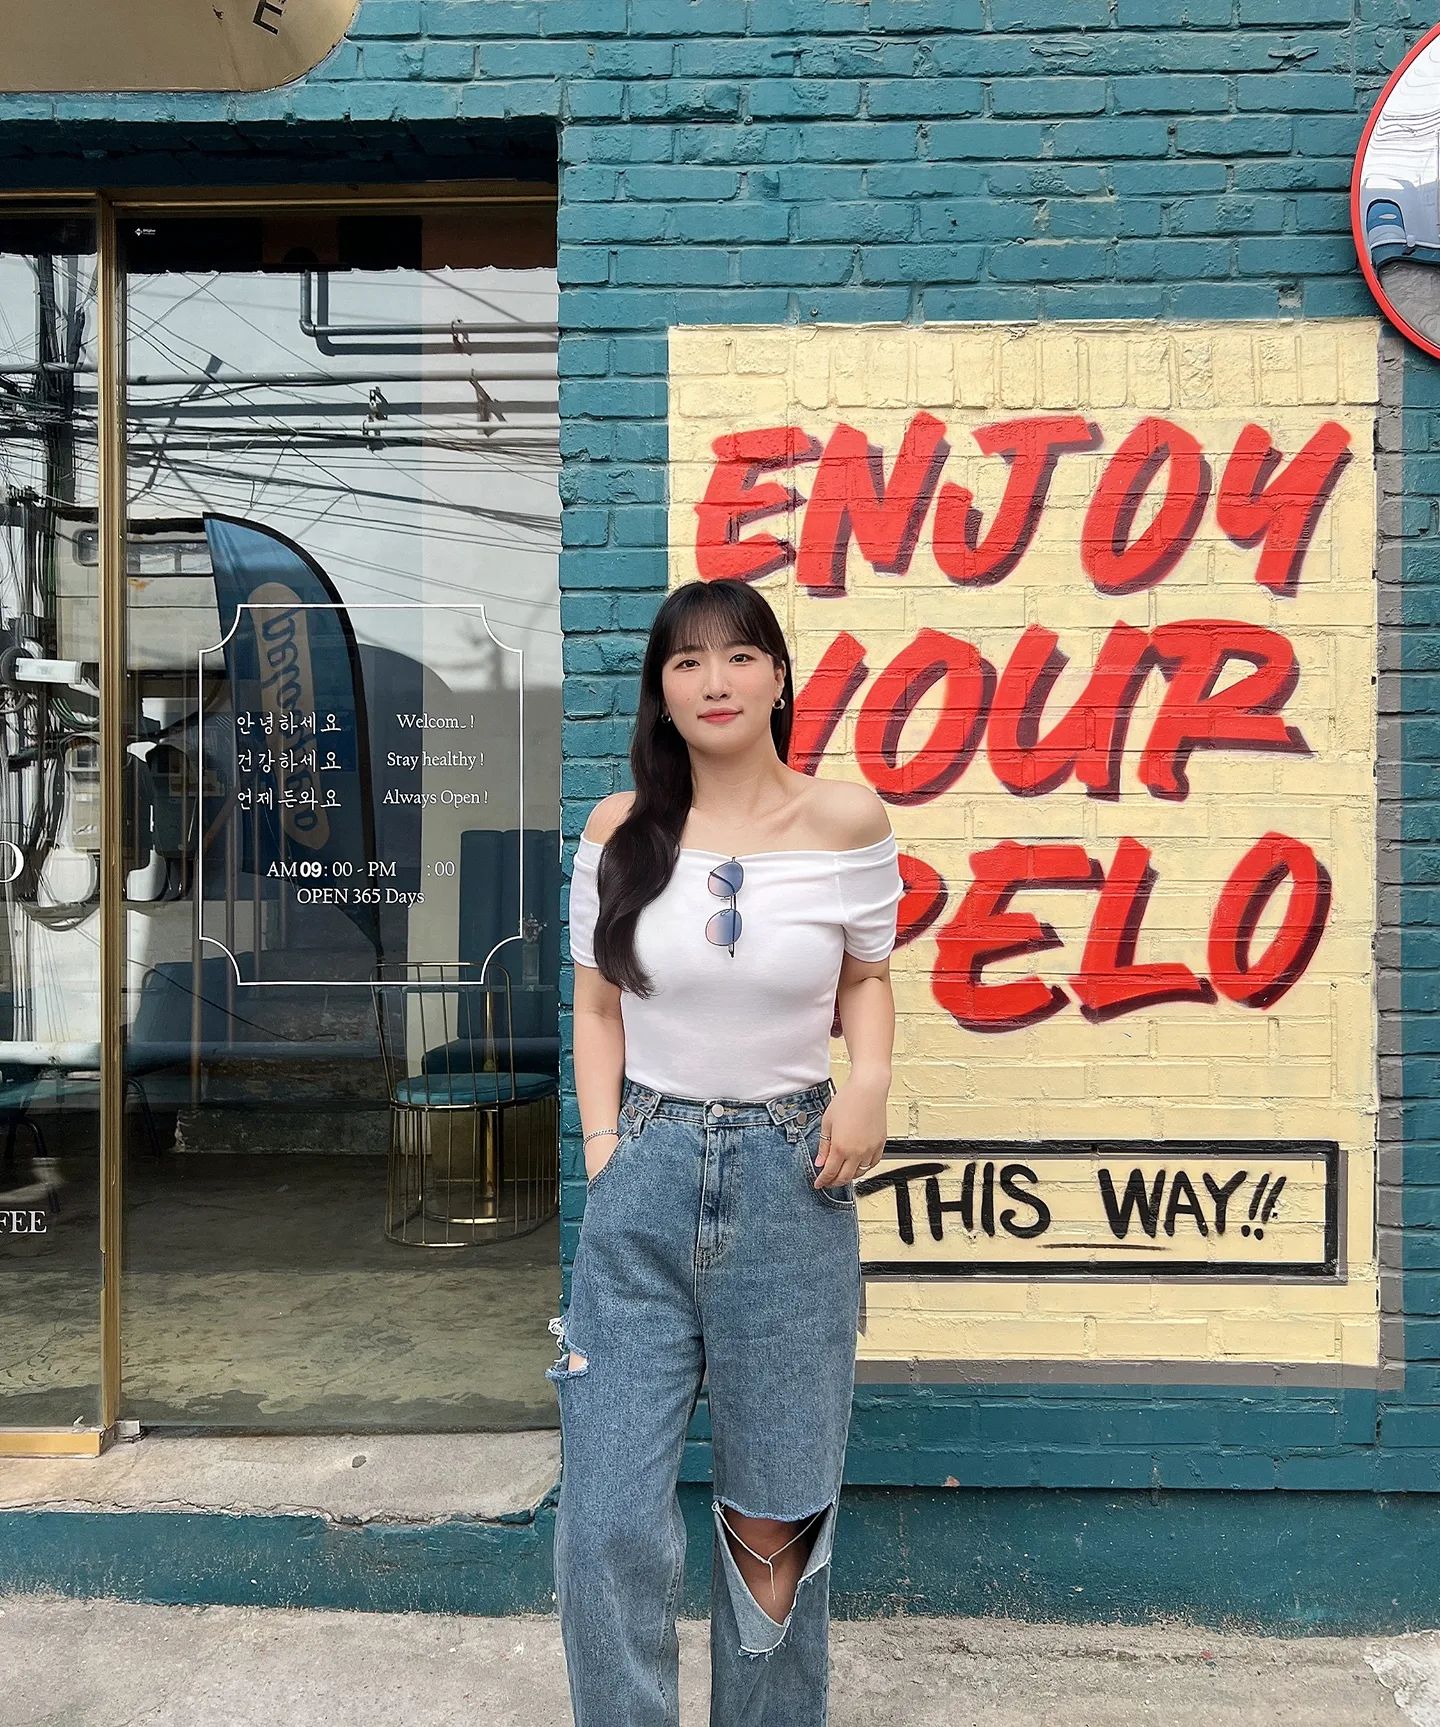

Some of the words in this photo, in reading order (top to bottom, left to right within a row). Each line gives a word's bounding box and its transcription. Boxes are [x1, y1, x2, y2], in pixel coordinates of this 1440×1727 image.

[695, 411, 1352, 598] ENJOY
[236, 711, 342, 735] 안녕하세요
[237, 749, 342, 773] 건강하세요
[387, 752, 419, 771] Stay
[422, 751, 476, 770] healthy
[237, 787, 342, 811] 언제든와요
[382, 789, 437, 809] Always
[440, 789, 480, 809] Open
[367, 861, 396, 877] PM
[296, 888, 349, 904] OPEN
[352, 888, 381, 904] 365
[385, 888, 425, 908] Days
[856, 1162, 1051, 1245] THIS
